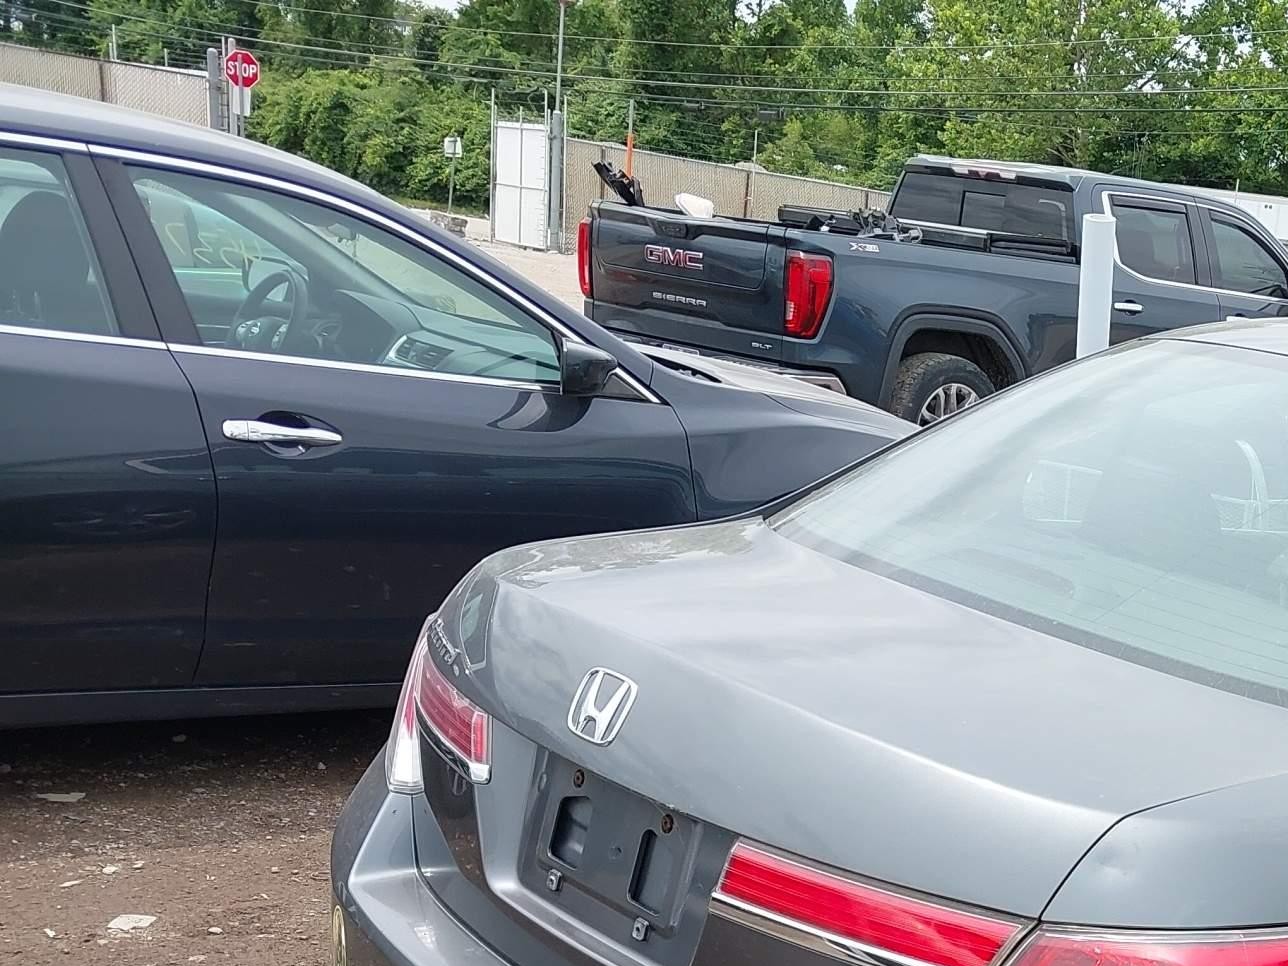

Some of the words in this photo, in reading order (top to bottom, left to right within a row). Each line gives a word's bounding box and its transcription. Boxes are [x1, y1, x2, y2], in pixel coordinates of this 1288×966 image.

[227, 60, 257, 79] STOP
[644, 244, 704, 270] GMC
[652, 291, 707, 307] SIERRA
[751, 342, 773, 350] SLT
